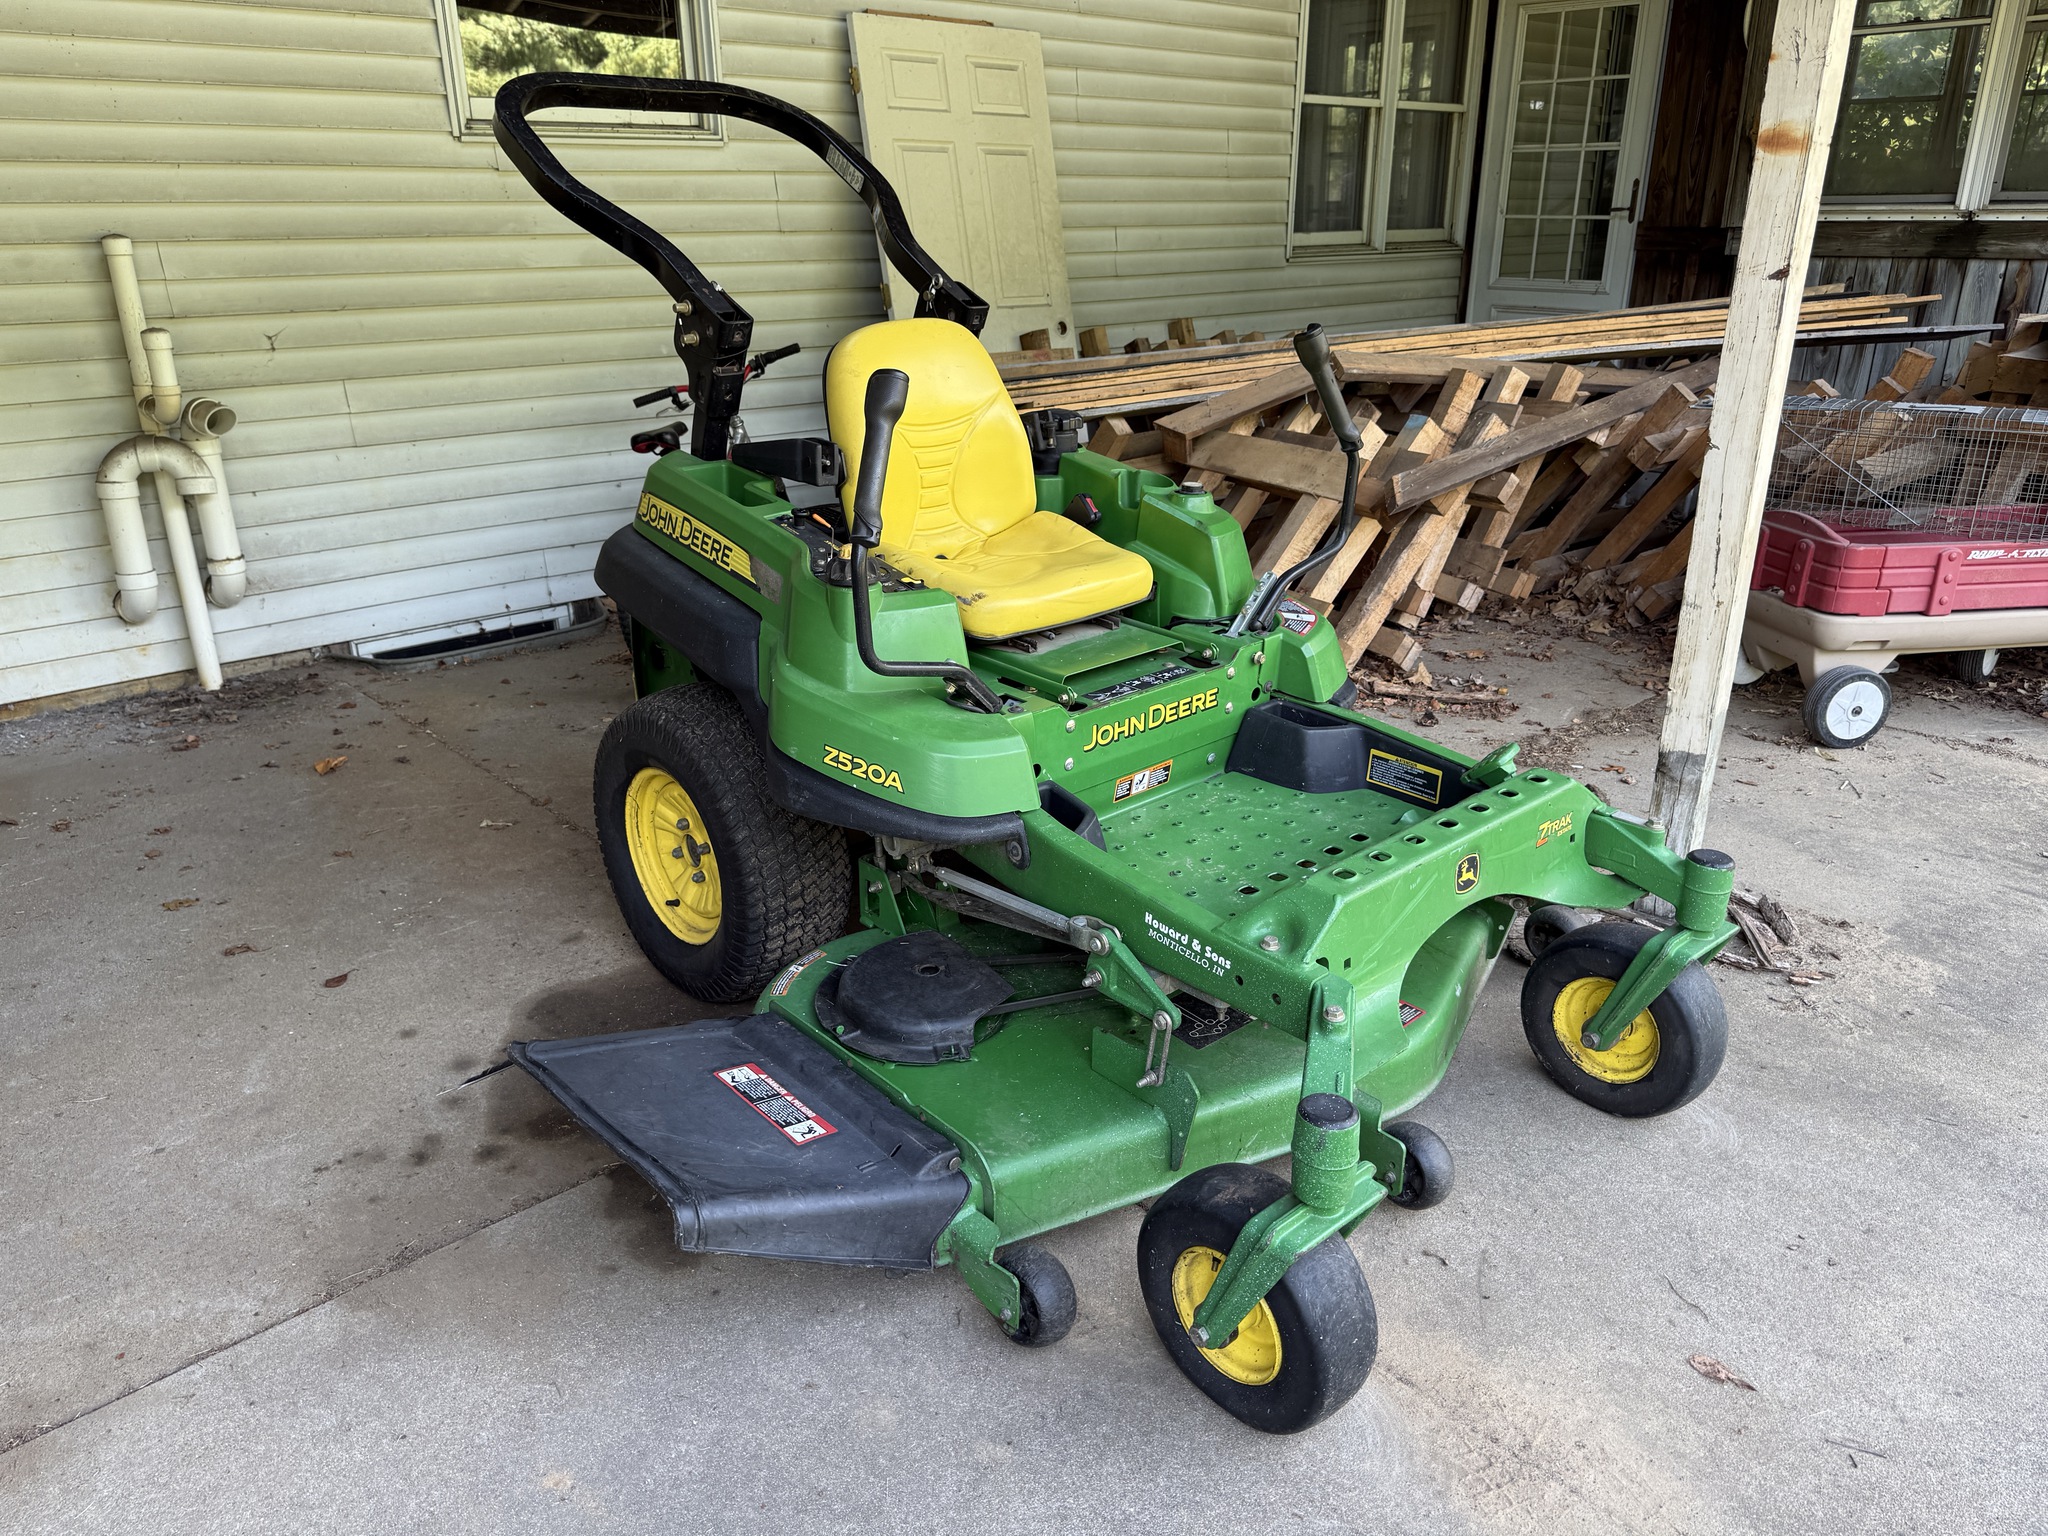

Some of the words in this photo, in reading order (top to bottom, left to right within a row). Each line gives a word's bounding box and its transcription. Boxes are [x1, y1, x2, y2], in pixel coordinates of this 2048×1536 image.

[642, 494, 679, 538] JOHN
[679, 516, 733, 569] DEERE
[1083, 712, 1146, 752] JOHN
[1148, 687, 1219, 730] DEERE
[822, 743, 905, 794] Z520A
[1145, 911, 1189, 945] Howard
[1191, 938, 1202, 953] &
[1204, 945, 1232, 970] Sons
[1148, 928, 1211, 971] MONTICELLO,
[1212, 964, 1225, 977] IN
